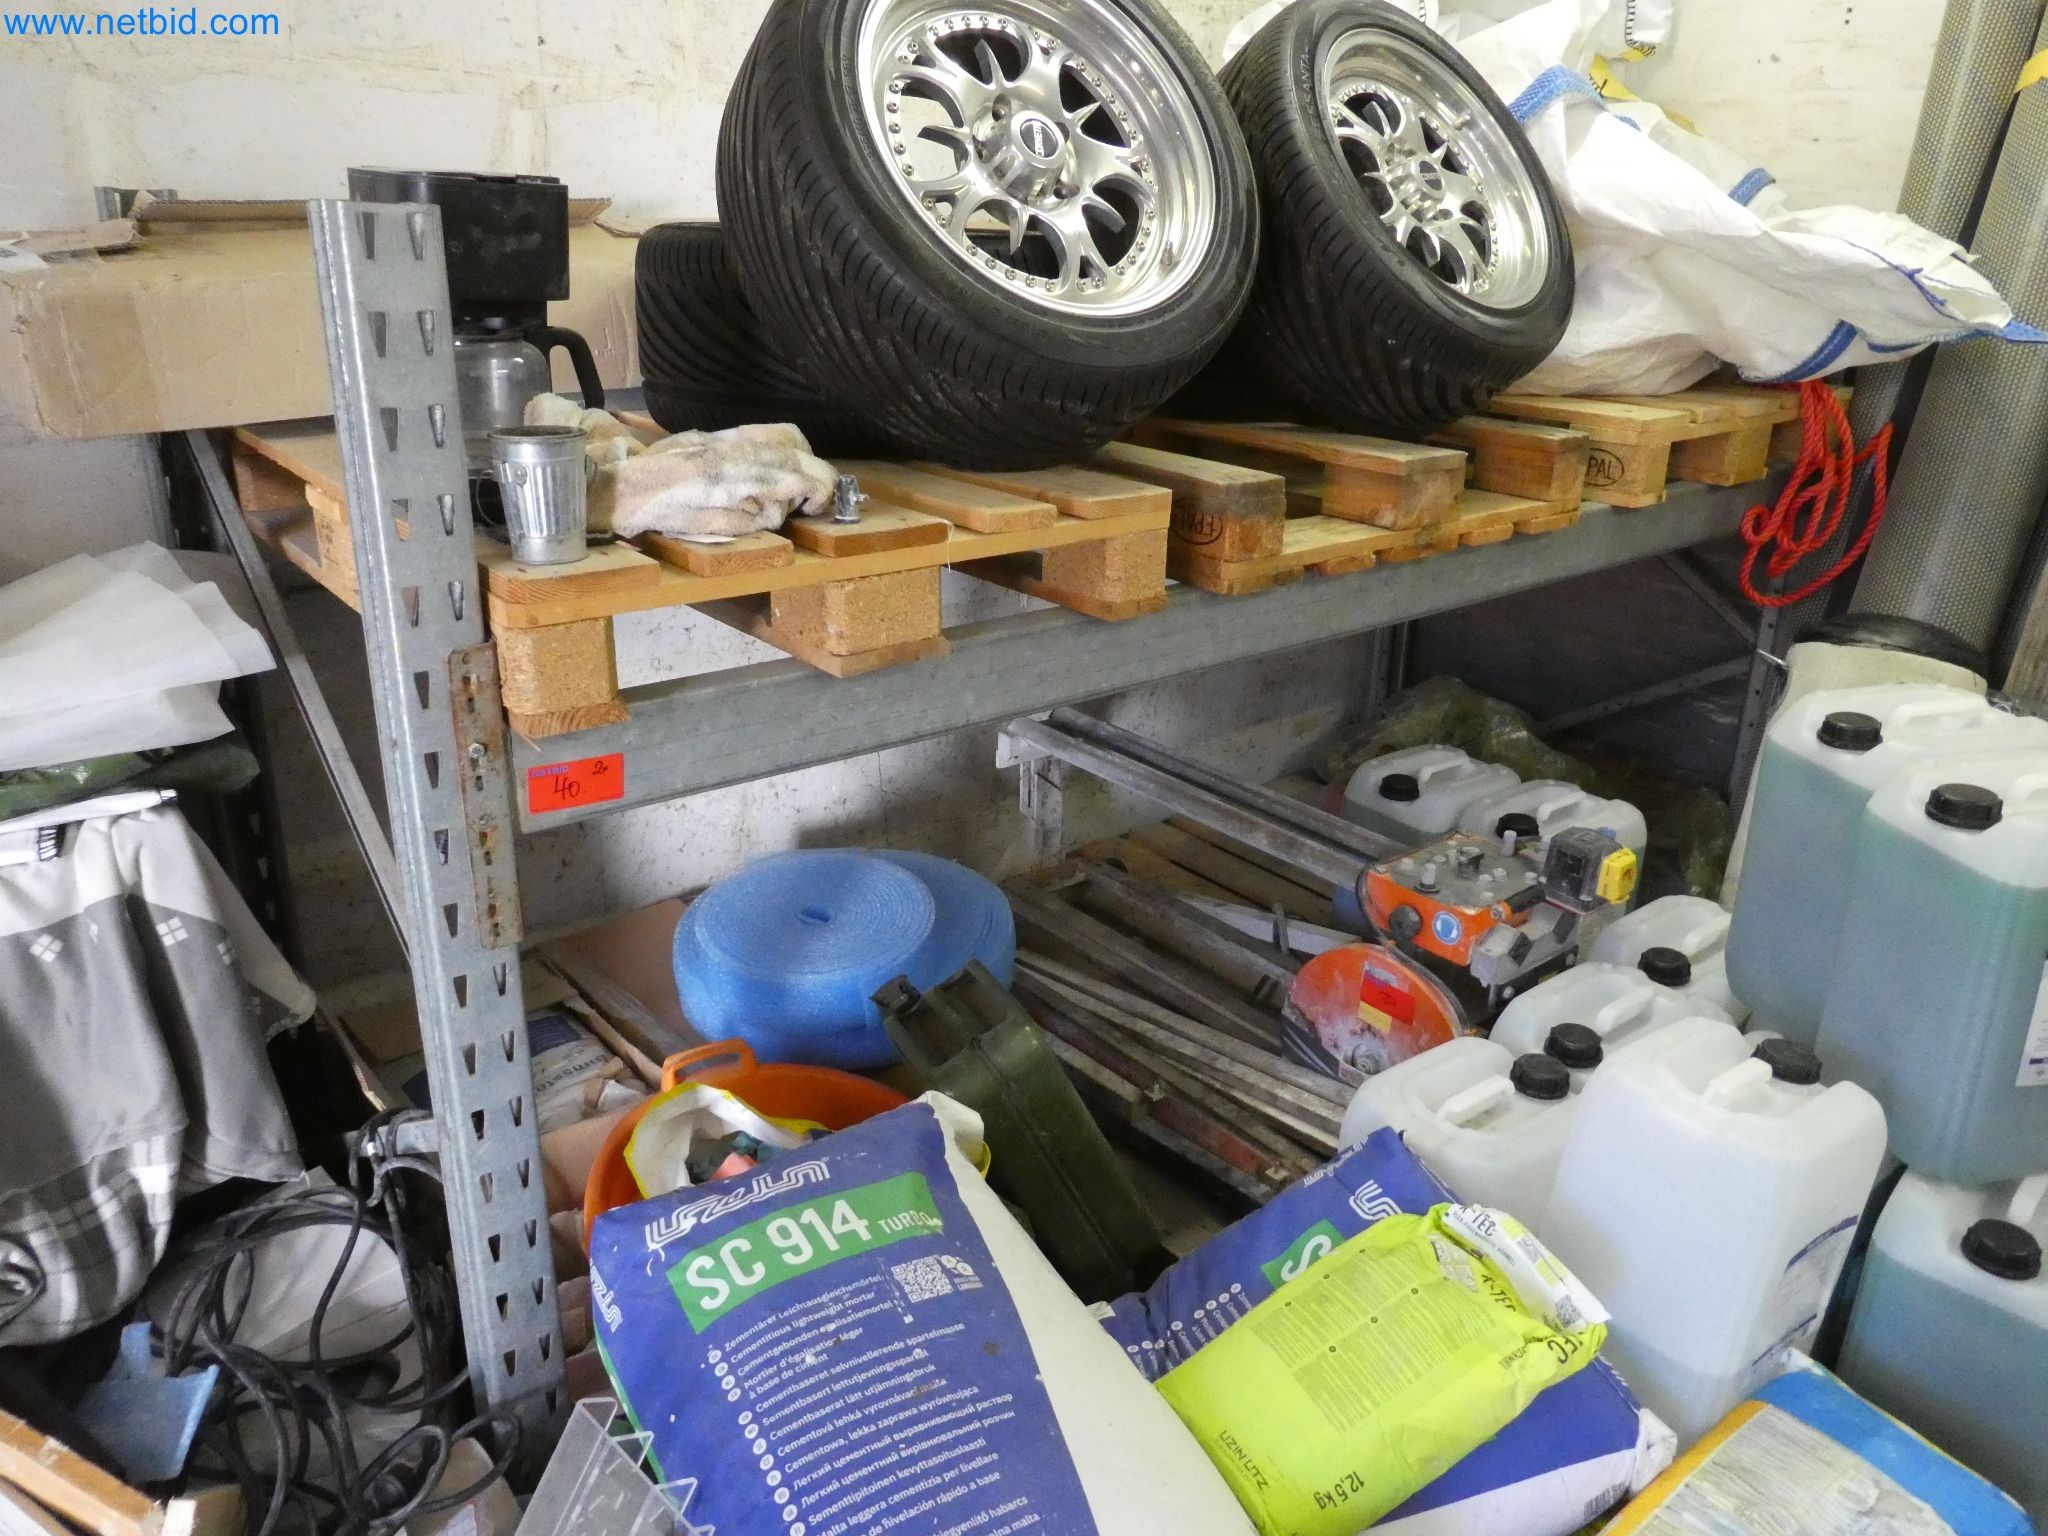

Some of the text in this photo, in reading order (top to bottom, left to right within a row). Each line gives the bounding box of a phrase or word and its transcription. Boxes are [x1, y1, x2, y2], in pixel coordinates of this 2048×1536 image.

[1584, 455, 1616, 480] PAL
[685, 1199, 933, 1310] SC 914 TURBO
[729, 1322, 792, 1363] Cementitious
[791, 1303, 844, 1329] lightweight
[844, 1292, 875, 1307] mortar
[736, 1327, 819, 1376] Cementgebonden
[743, 1364, 778, 1389] Mortier
[754, 1369, 829, 1413] Cementbaseret
[756, 1376, 780, 1394] base
[780, 1368, 794, 1379] de
[761, 1386, 831, 1426] Sementbasert
[768, 1398, 845, 1440] Cementbaserat
[776, 1420, 834, 1456] Cementová
[834, 1408, 862, 1427] lehká
[783, 1436, 848, 1474] Cementowa,
[847, 1421, 876, 1440] lekka
[876, 1406, 918, 1428] zaprawa
[792, 1462, 832, 1490] Легкий
[832, 1434, 892, 1469] цементный
[800, 1478, 840, 1508] Легкий
[840, 1451, 899, 1485] цементний
[807, 1473, 896, 1526] Sementtipitoinen
[846, 1500, 887, 1526] leggera
[887, 1474, 942, 1505] cementizia
[942, 1467, 960, 1481] per
[959, 1450, 999, 1473] livellare
[868, 1520, 883, 1536] de
[935, 1482, 969, 1504] rápido
[975, 1470, 1001, 1486] base
[988, 1495, 1028, 1518] habarcs
[1313, 1490, 1338, 1510] kg
[1011, 1511, 1041, 1530] malta
